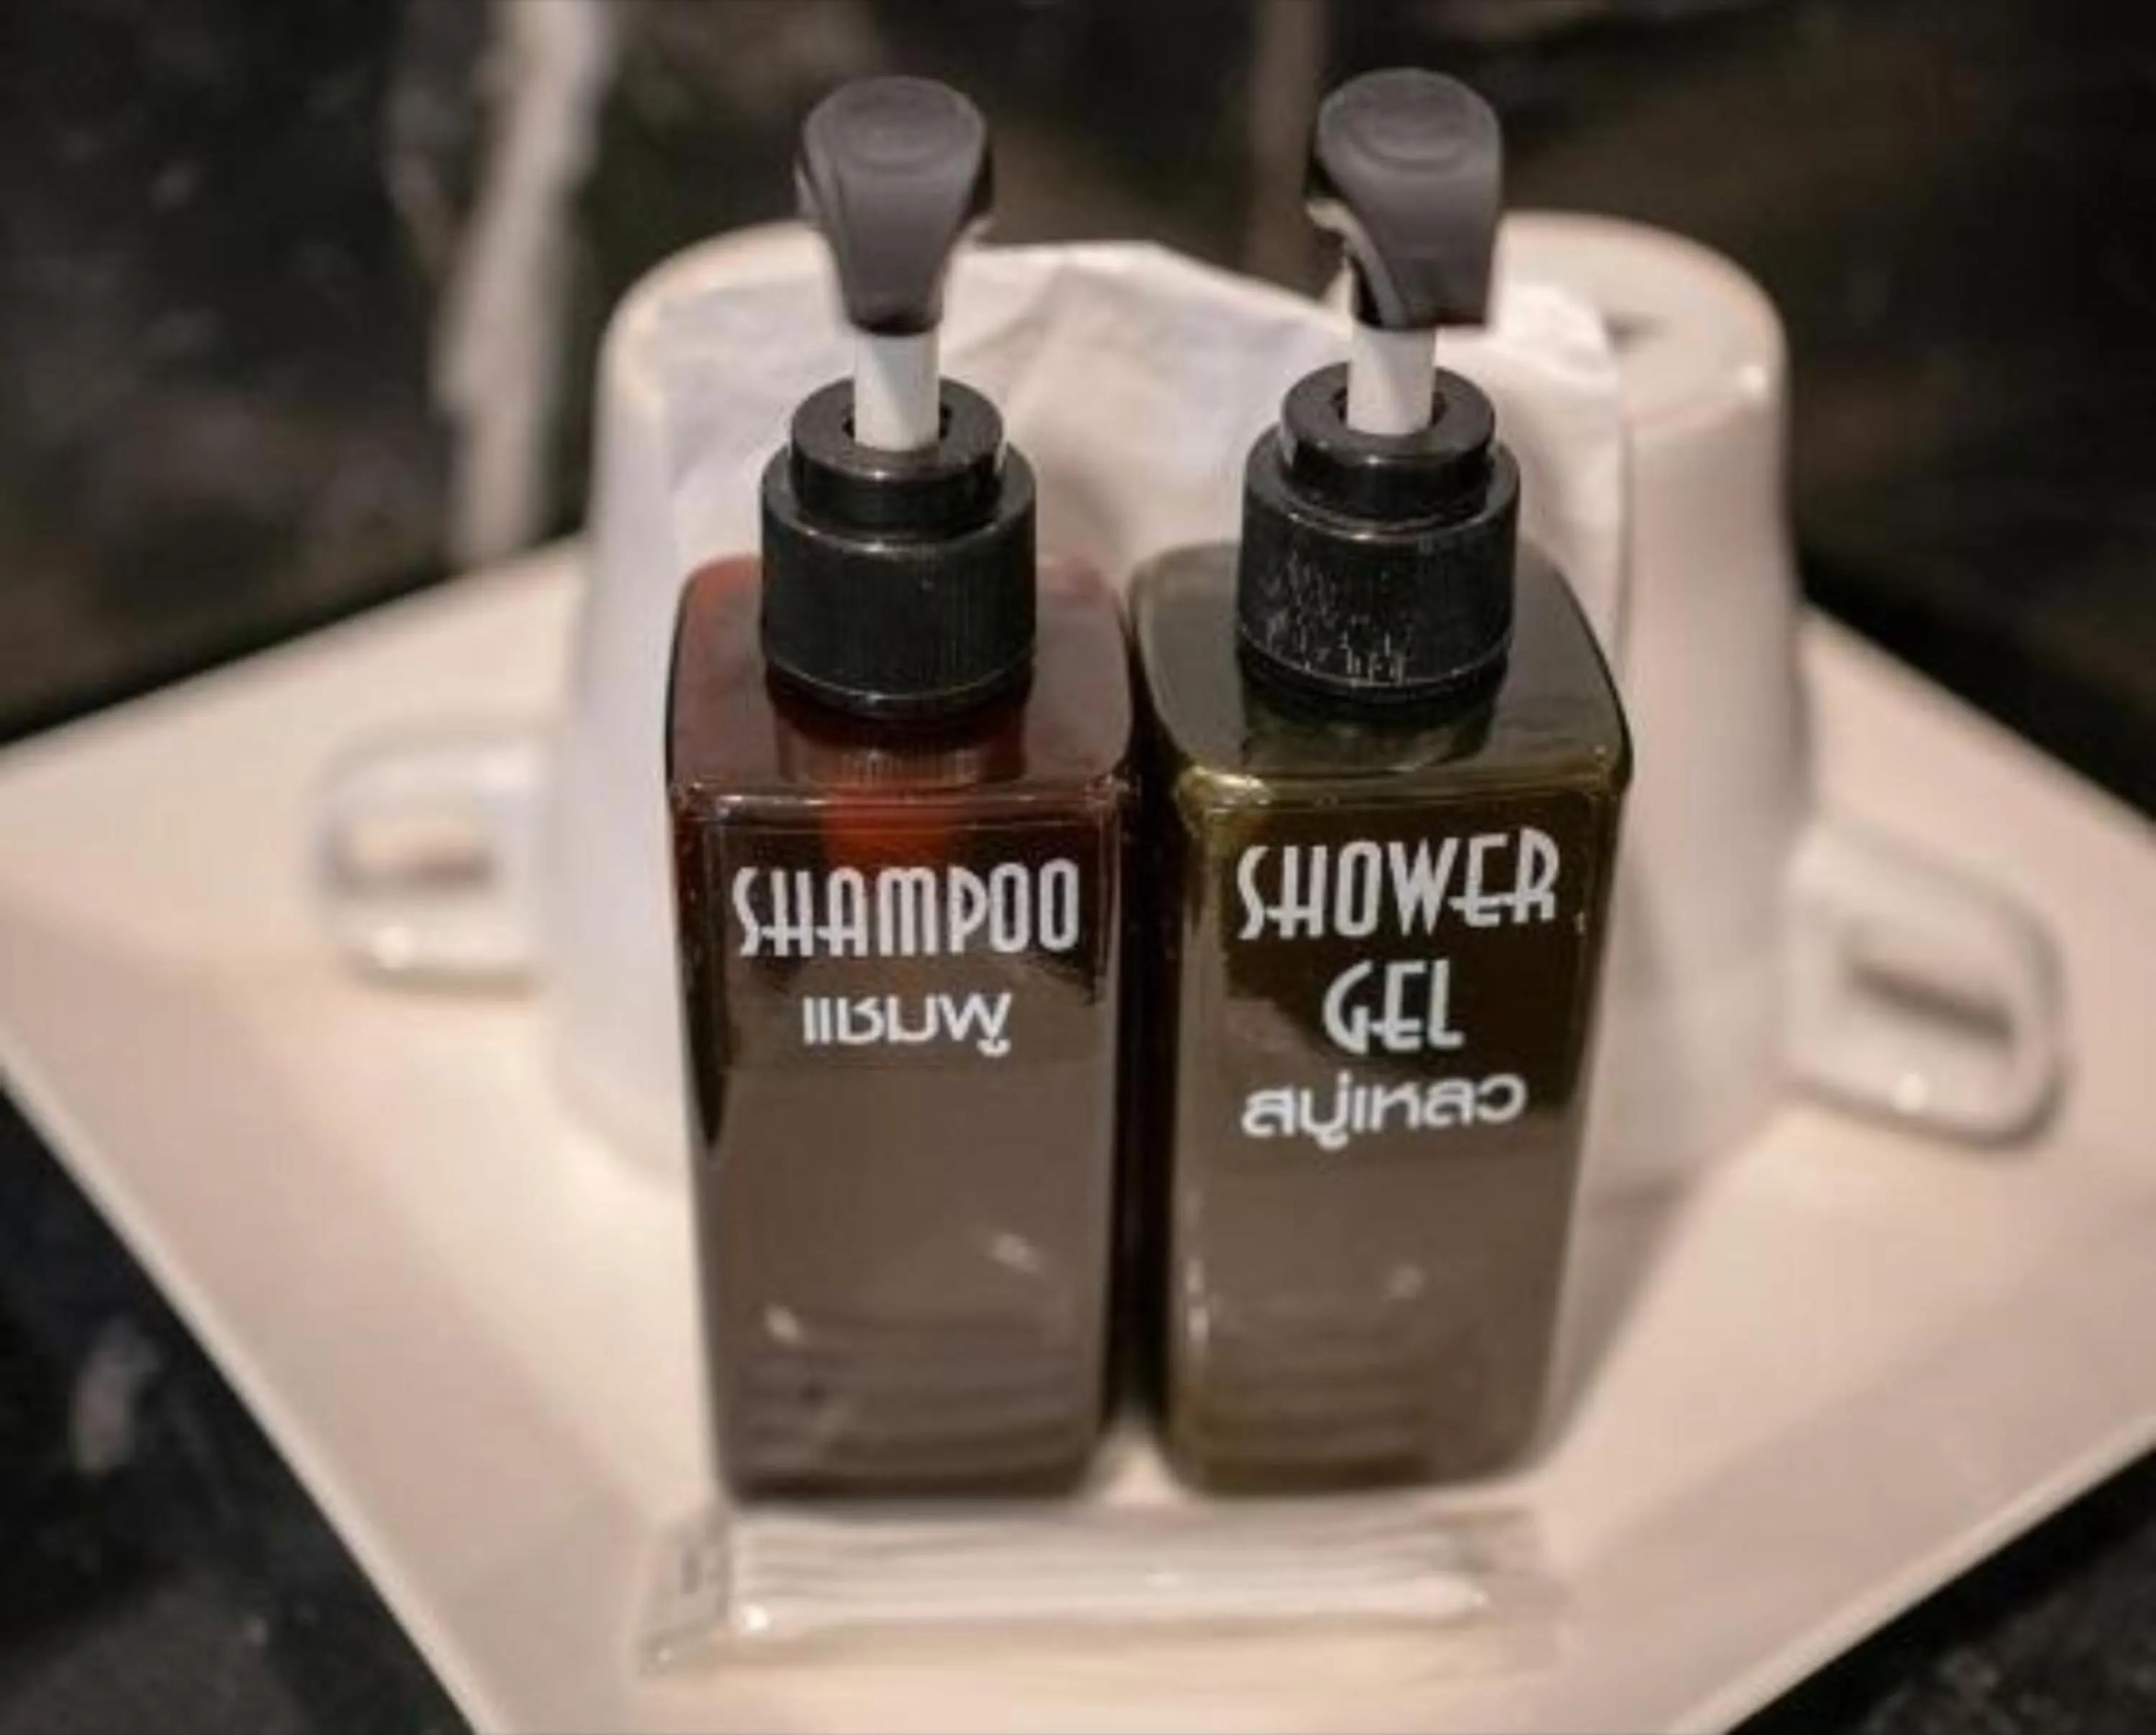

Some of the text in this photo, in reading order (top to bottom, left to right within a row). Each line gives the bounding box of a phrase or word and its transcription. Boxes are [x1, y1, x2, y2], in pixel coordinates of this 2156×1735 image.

[732, 860, 1079, 957] SHAMPOO
[1237, 828, 1560, 939] SHOWER
[803, 992, 1013, 1057] แชมพู
[1324, 959, 1466, 1054] GEL
[1240, 1071, 1526, 1150] สบู่เหลว
